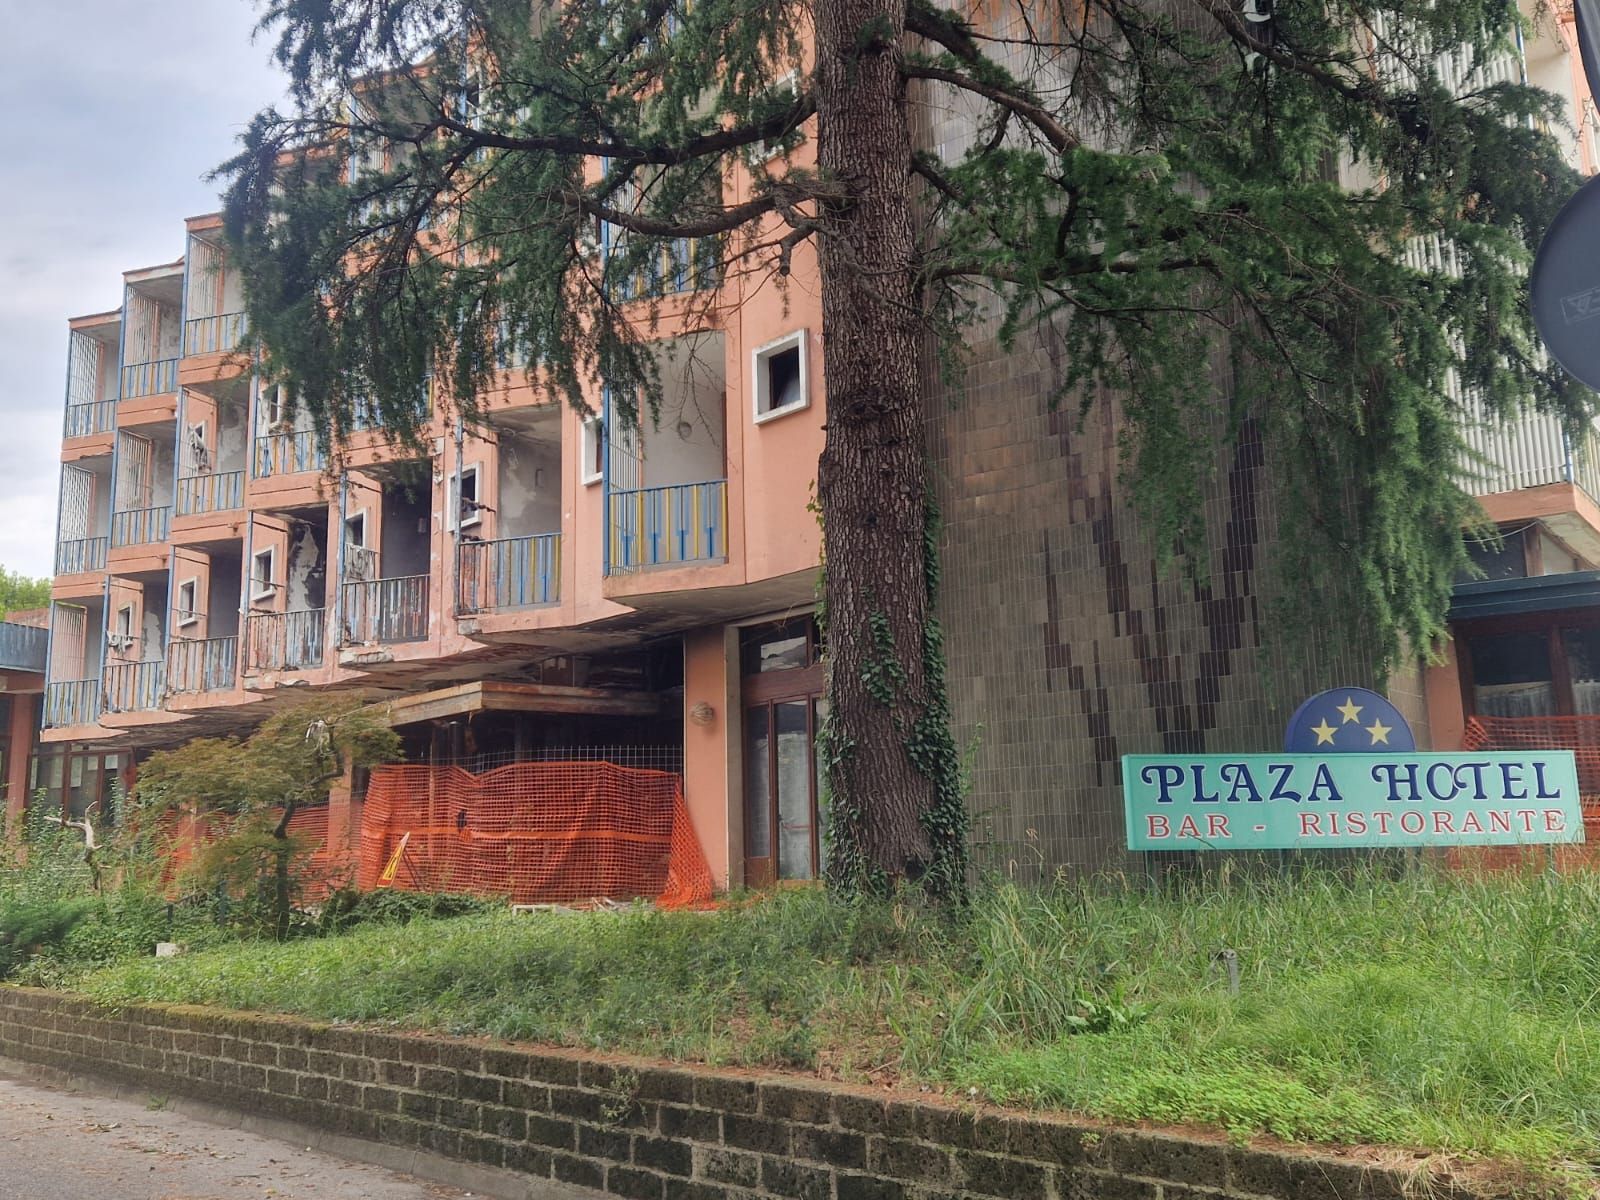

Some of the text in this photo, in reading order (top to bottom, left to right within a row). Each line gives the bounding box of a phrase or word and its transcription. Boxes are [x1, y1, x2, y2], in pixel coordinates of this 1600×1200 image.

[1141, 761, 1561, 804] PLAZA HOTEL
[1146, 814, 1232, 838] BAR
[1299, 809, 1566, 836] RISTORANTE
